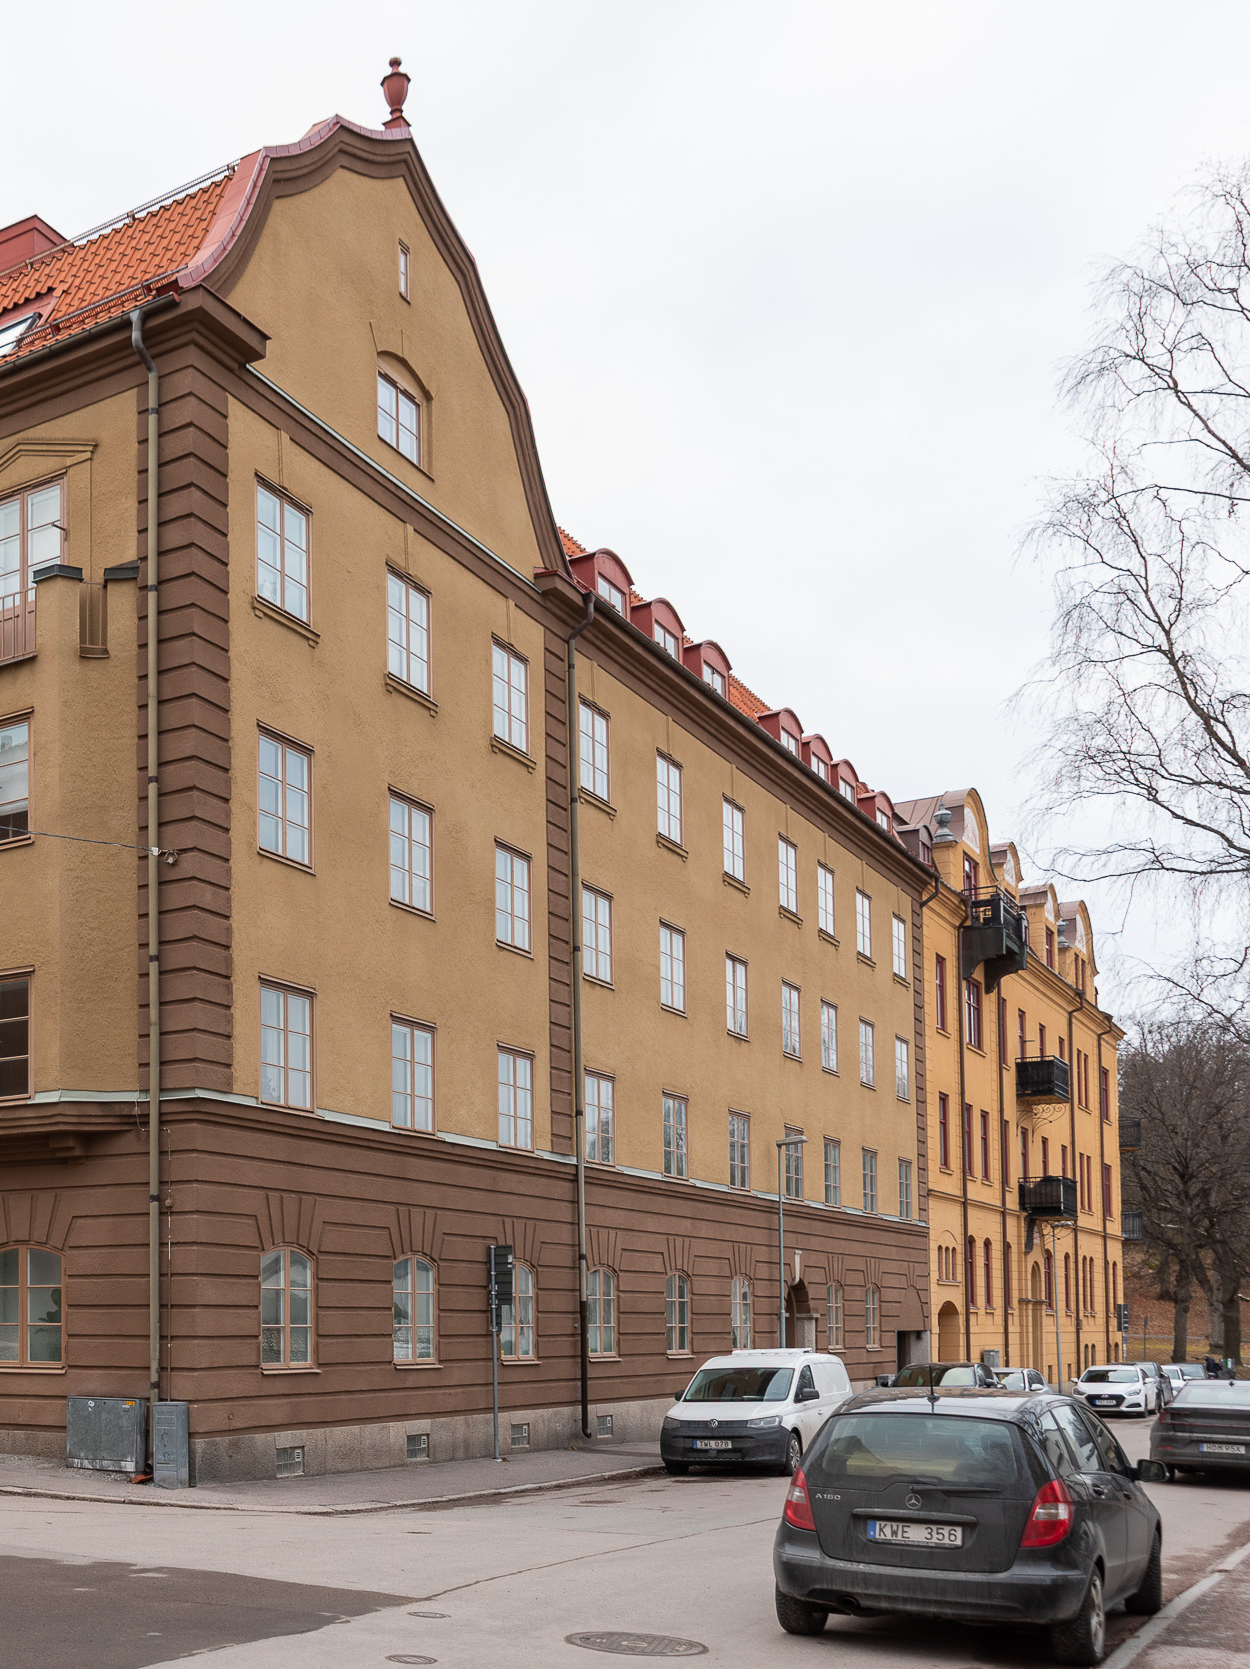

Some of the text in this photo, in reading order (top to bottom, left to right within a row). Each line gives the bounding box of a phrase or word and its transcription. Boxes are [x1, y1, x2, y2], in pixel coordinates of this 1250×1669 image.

[699, 1440, 712, 1448] TWL
[878, 1523, 957, 1542] KWE 356
